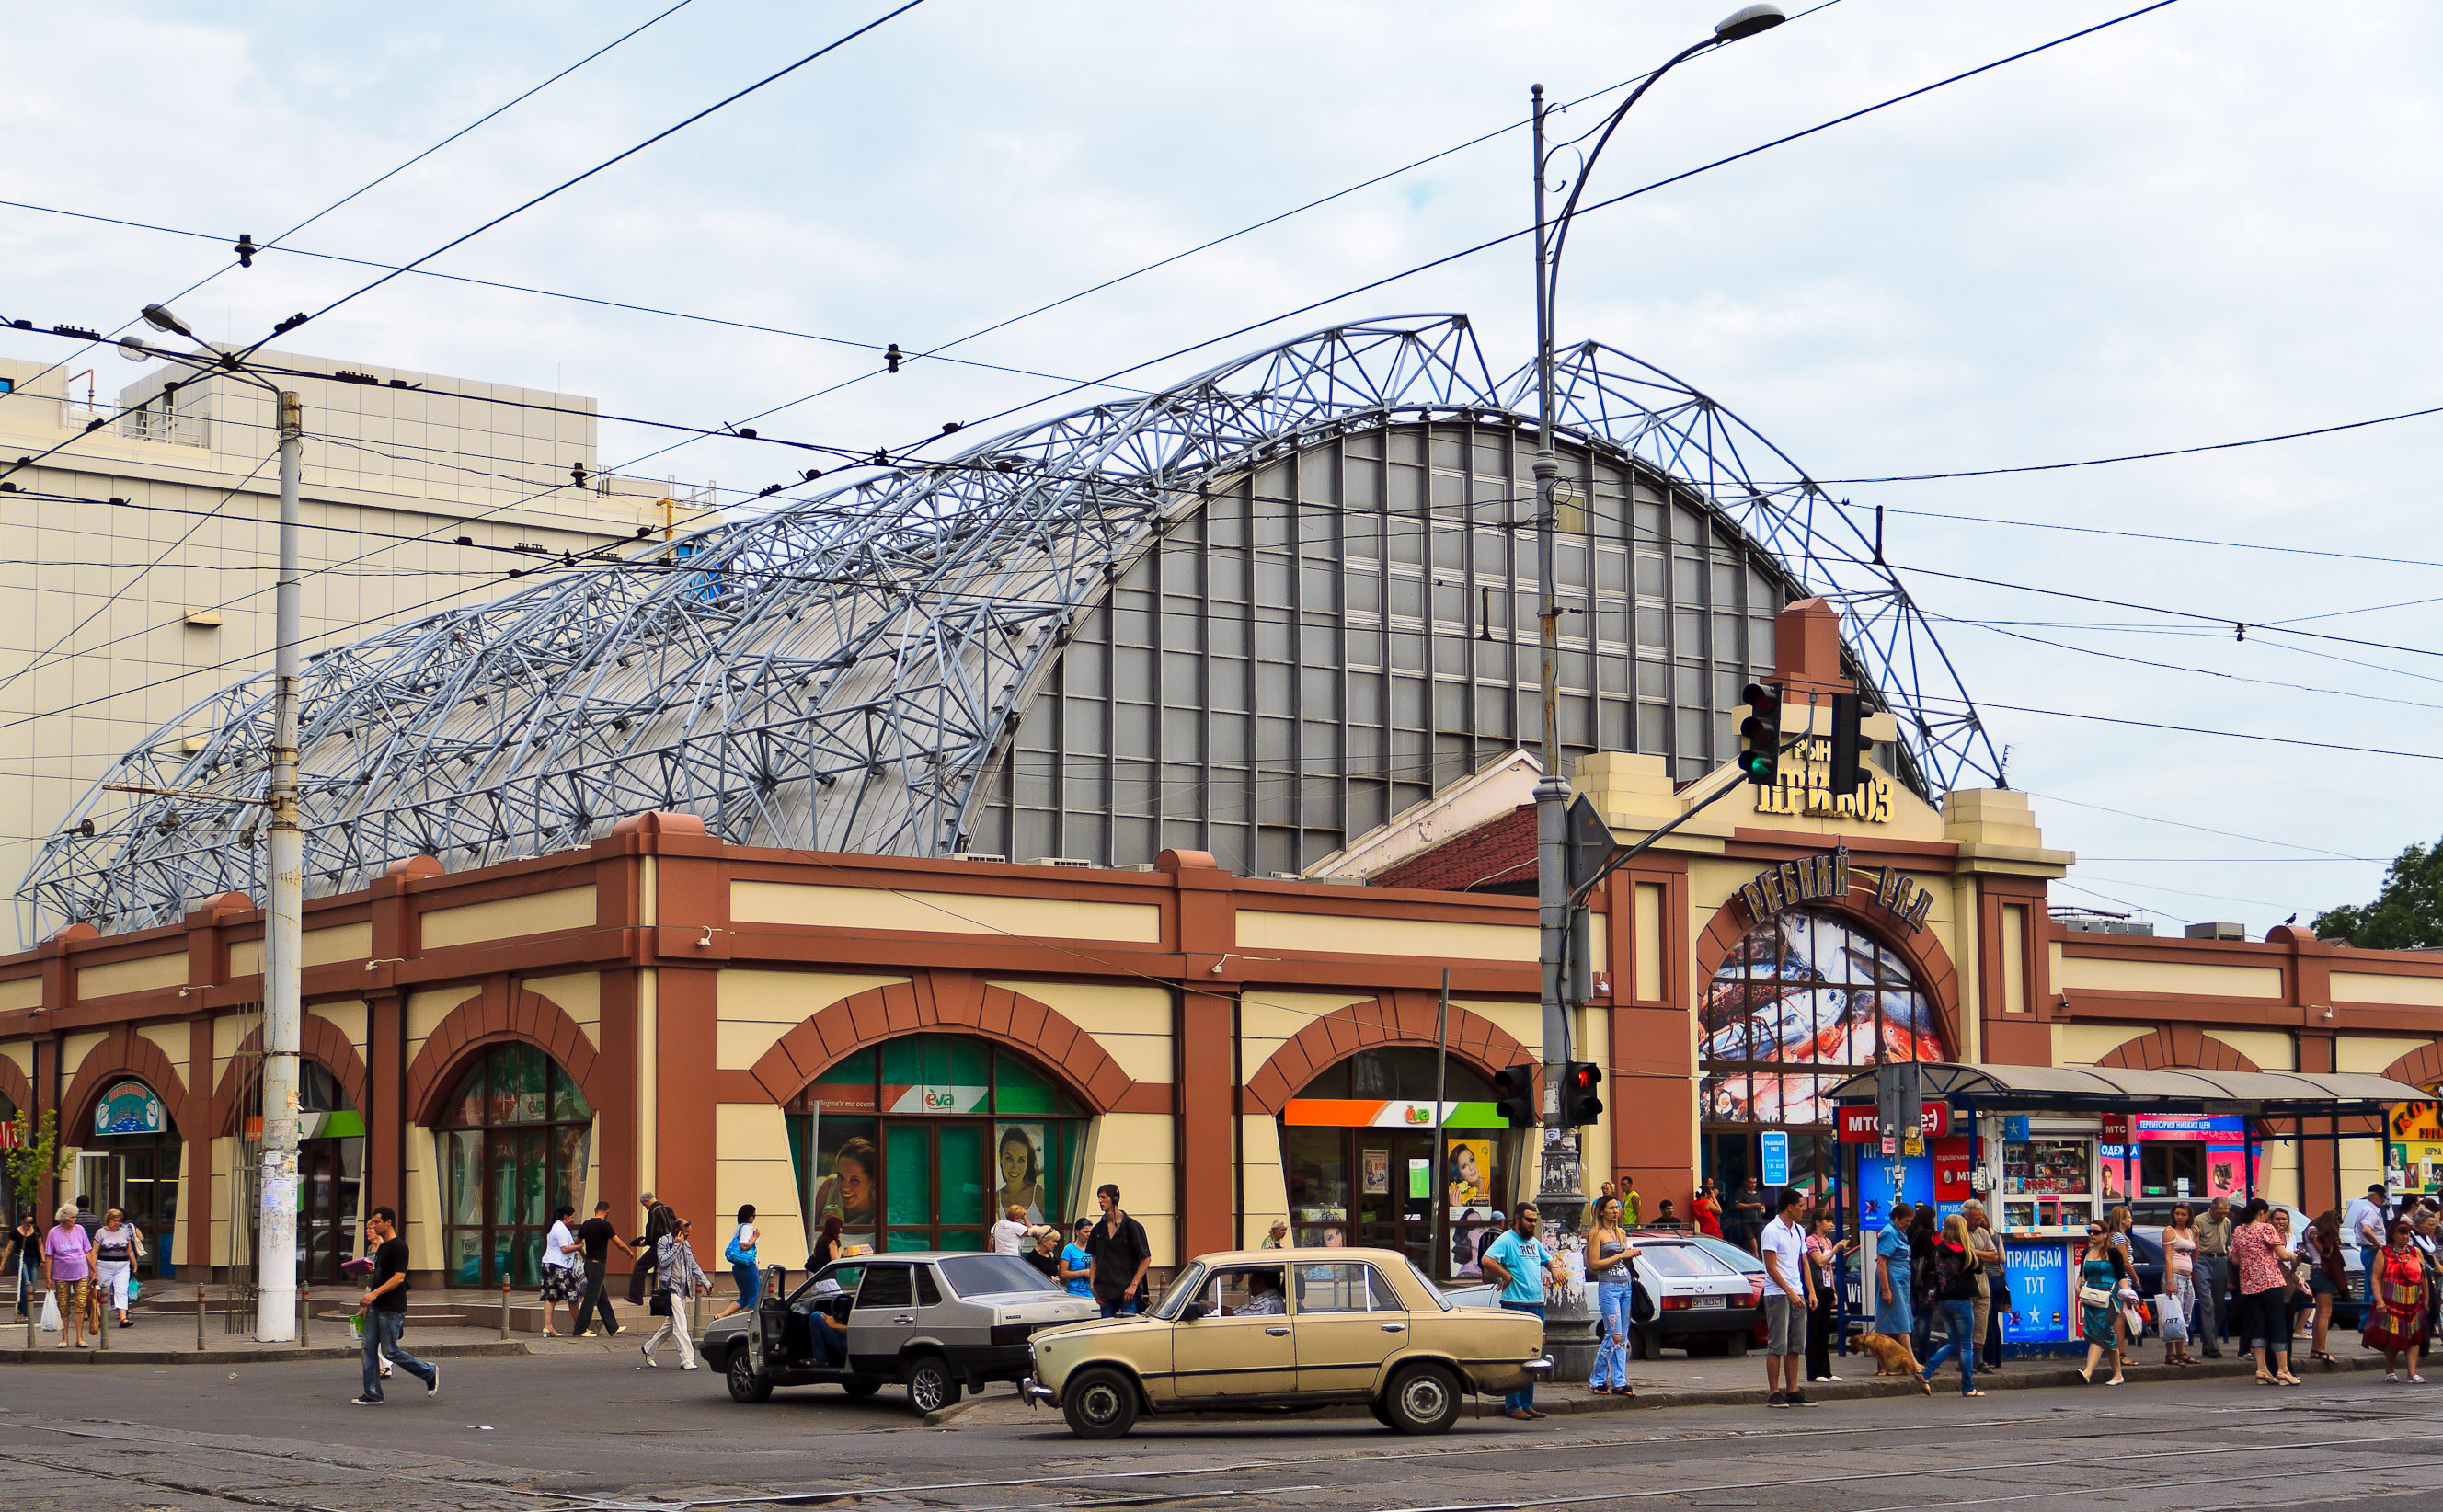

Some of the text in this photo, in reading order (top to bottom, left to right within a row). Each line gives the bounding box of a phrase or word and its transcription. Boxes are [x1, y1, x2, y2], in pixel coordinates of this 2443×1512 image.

[1795, 739, 1832, 762] РЫН
[1875, 865, 1934, 934] РЯД
[2105, 1125, 2127, 1134] МТС
[2139, 1120, 2211, 1129] ТЕРРИТОРИЯ НИЗКИХ ЦЕН
[2101, 1144, 2139, 1157] ОДЕЖА
[1956, 1171, 1970, 1181] МТ
[1940, 1204, 1960, 1214] ПРИДБ
[2006, 1246, 2062, 1271] ПРИДБАЙ
[2024, 1276, 2046, 1295] ТУТ
